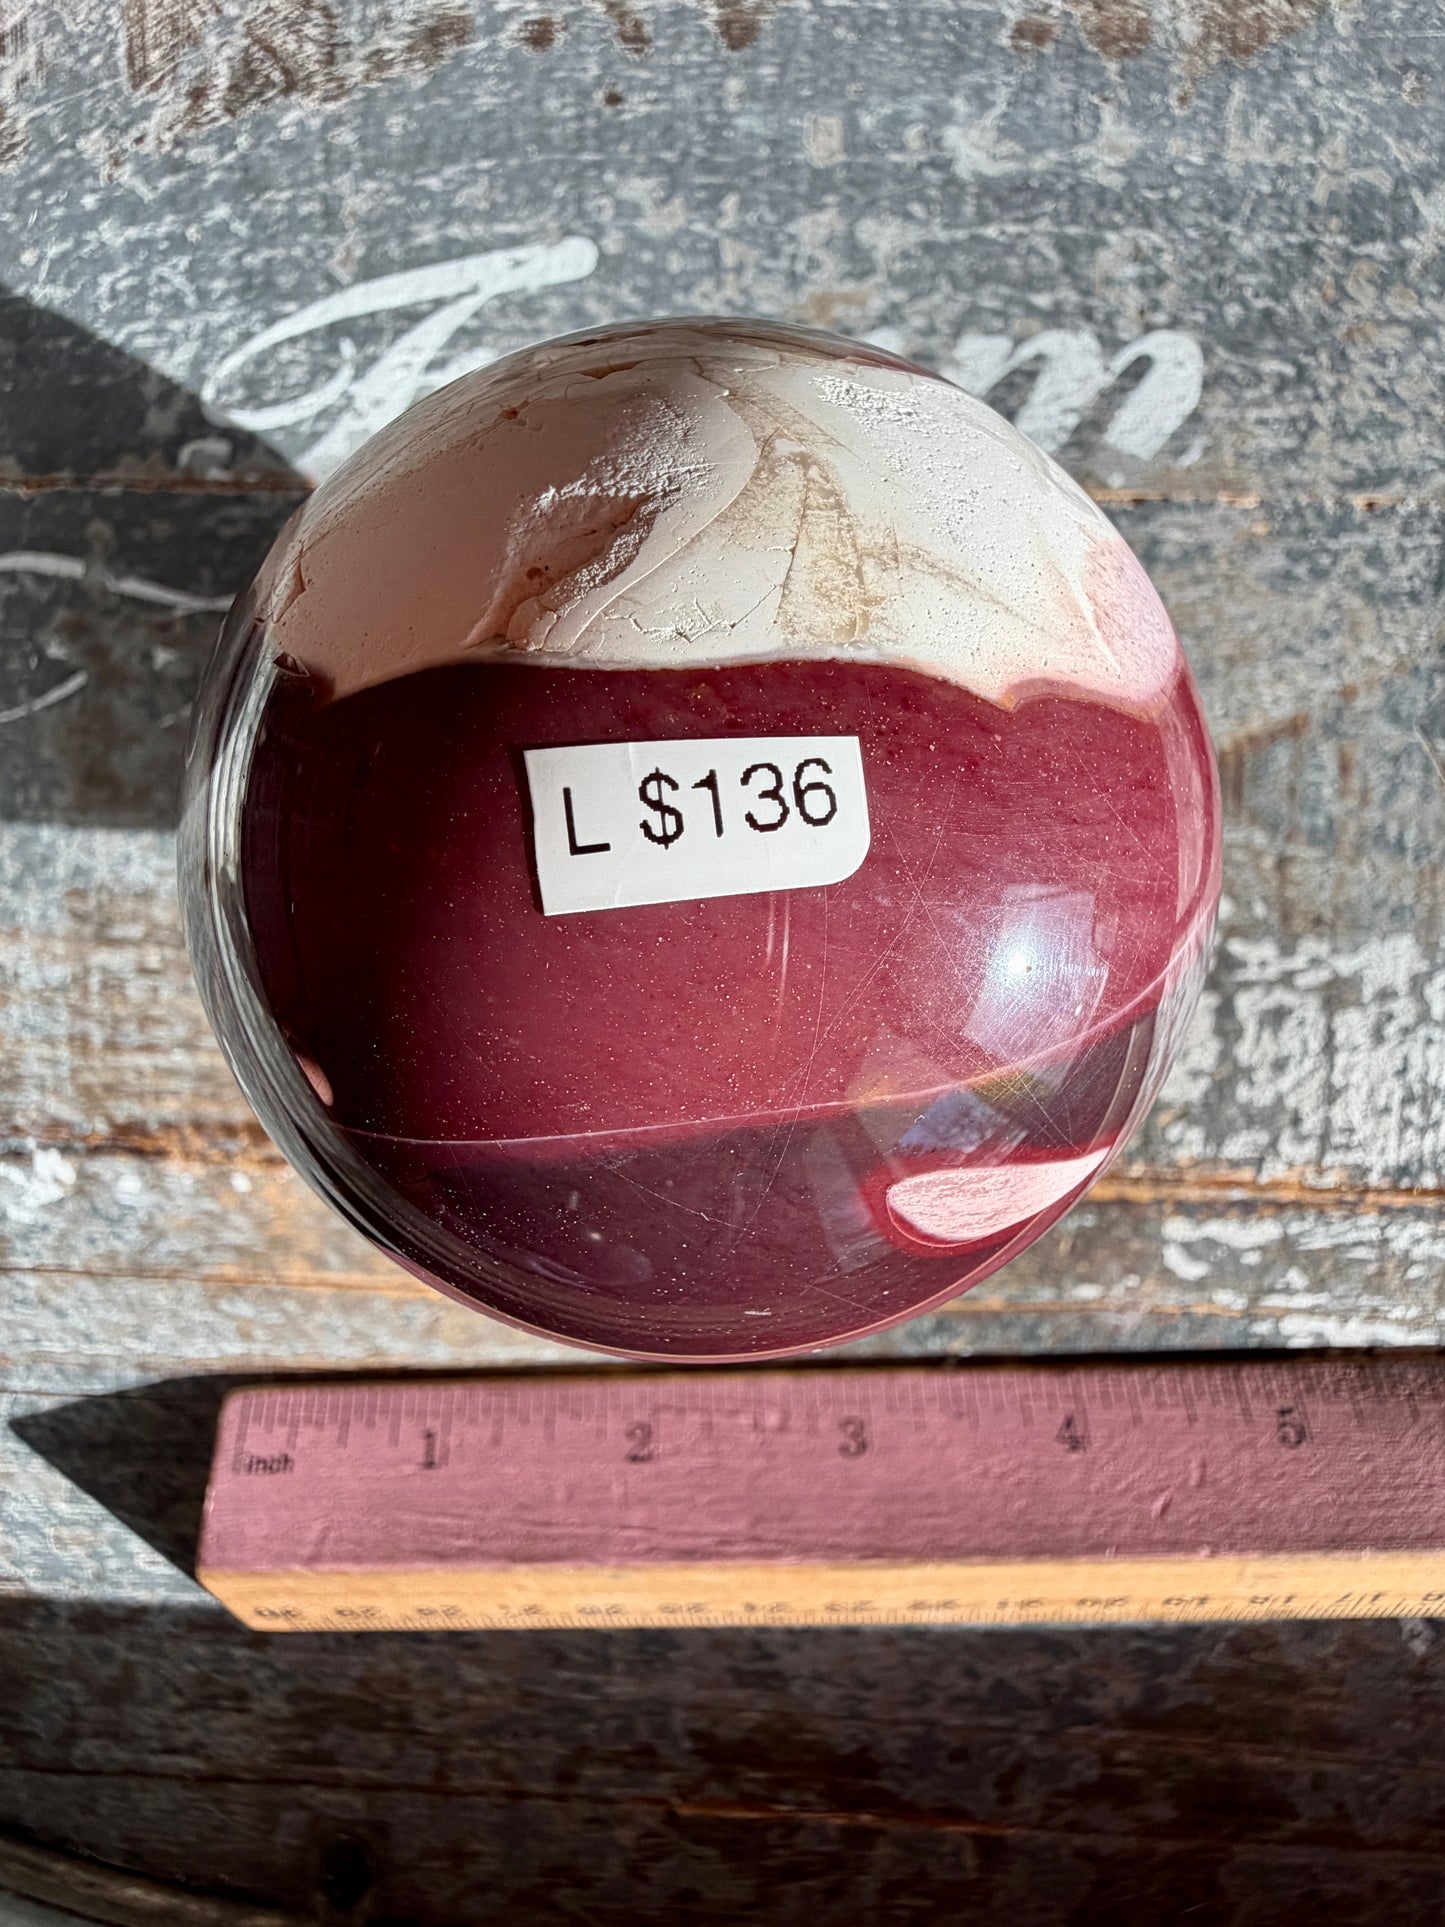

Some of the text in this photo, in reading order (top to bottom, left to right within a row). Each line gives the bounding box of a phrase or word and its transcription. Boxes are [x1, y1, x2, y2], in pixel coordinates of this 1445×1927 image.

[563, 758, 838, 856] L $136
[246, 1453, 294, 1474] inch
[422, 1406, 1307, 1469] 1 2 3 4 5
